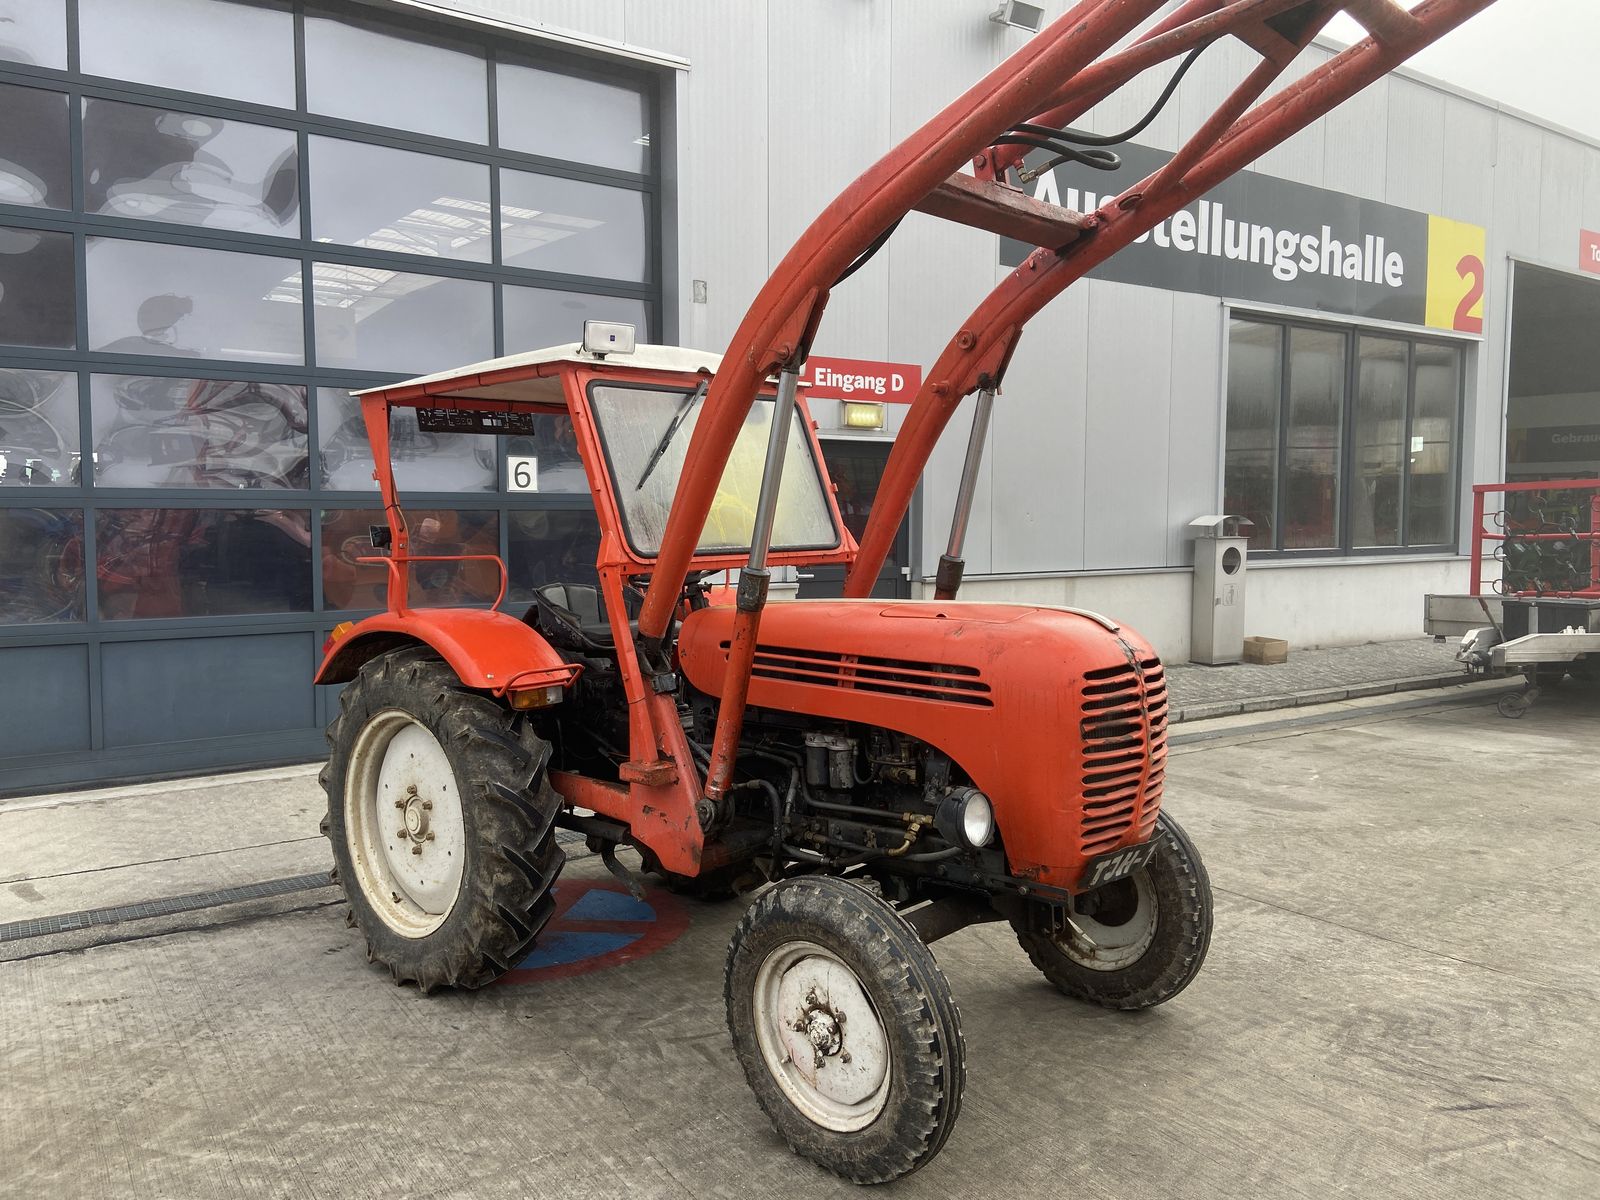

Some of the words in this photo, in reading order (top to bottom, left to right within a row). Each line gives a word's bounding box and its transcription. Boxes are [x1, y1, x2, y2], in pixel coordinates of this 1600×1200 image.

[1452, 254, 1485, 335] 2
[815, 367, 887, 394] Eingang
[891, 373, 904, 392] D
[1551, 432, 1600, 444] Gebrau
[514, 461, 531, 489] 6
